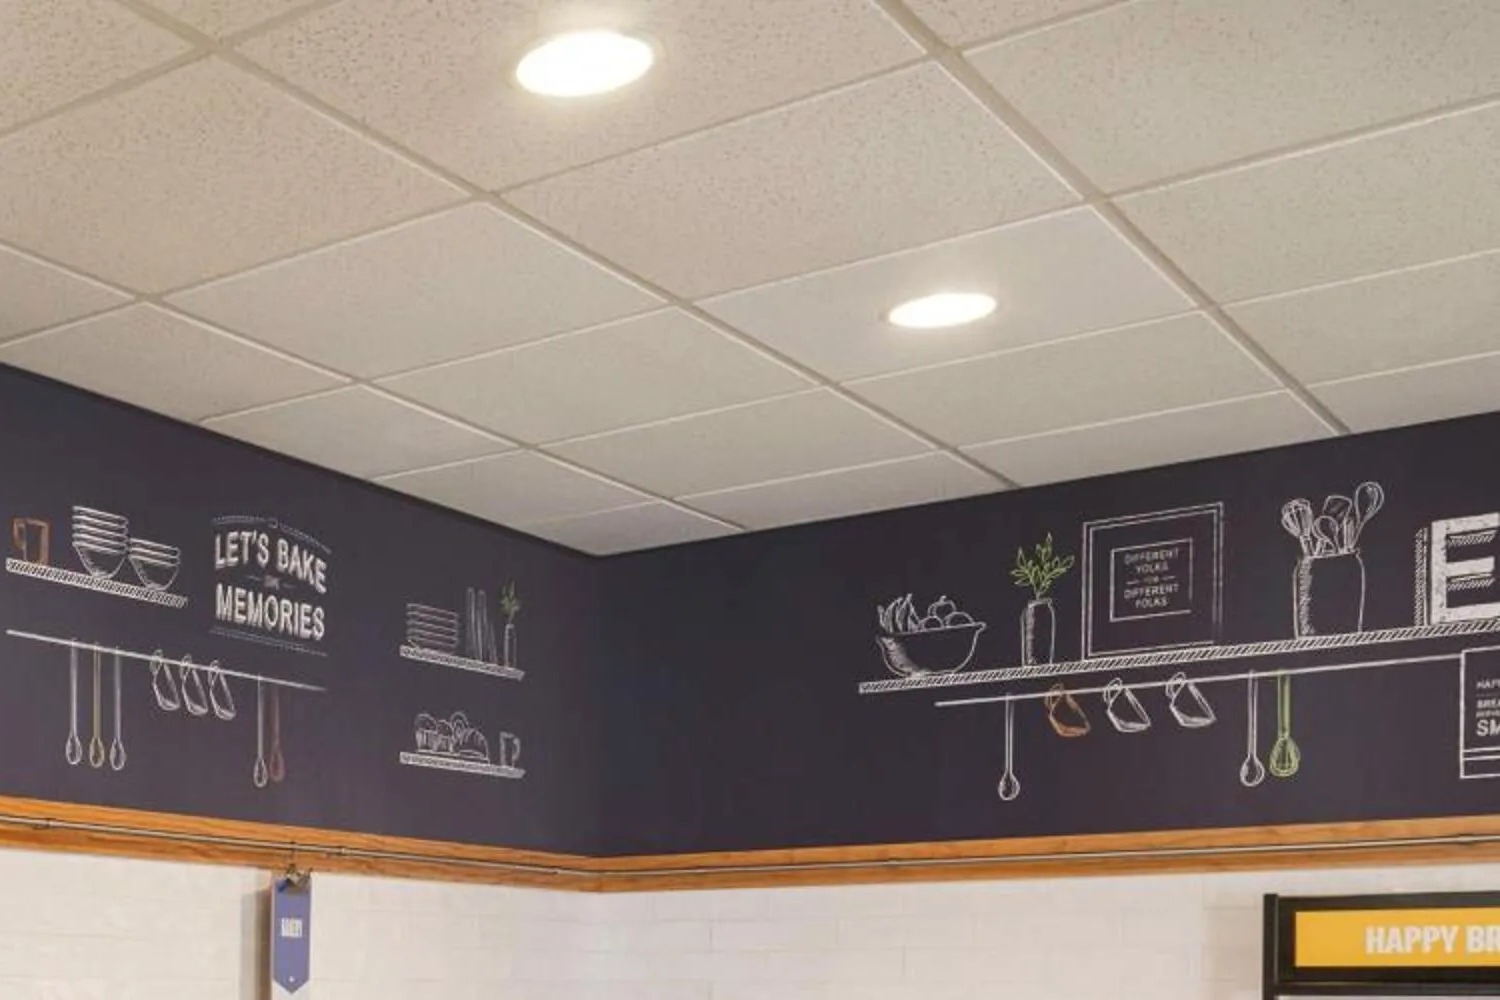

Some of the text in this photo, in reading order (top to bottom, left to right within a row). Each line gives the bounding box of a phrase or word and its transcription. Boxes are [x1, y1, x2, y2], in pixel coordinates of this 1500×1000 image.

[215, 529, 327, 594] LET'S BAKE
[215, 582, 325, 641] MEMORIES
[1365, 925, 1460, 954] HAPPY
